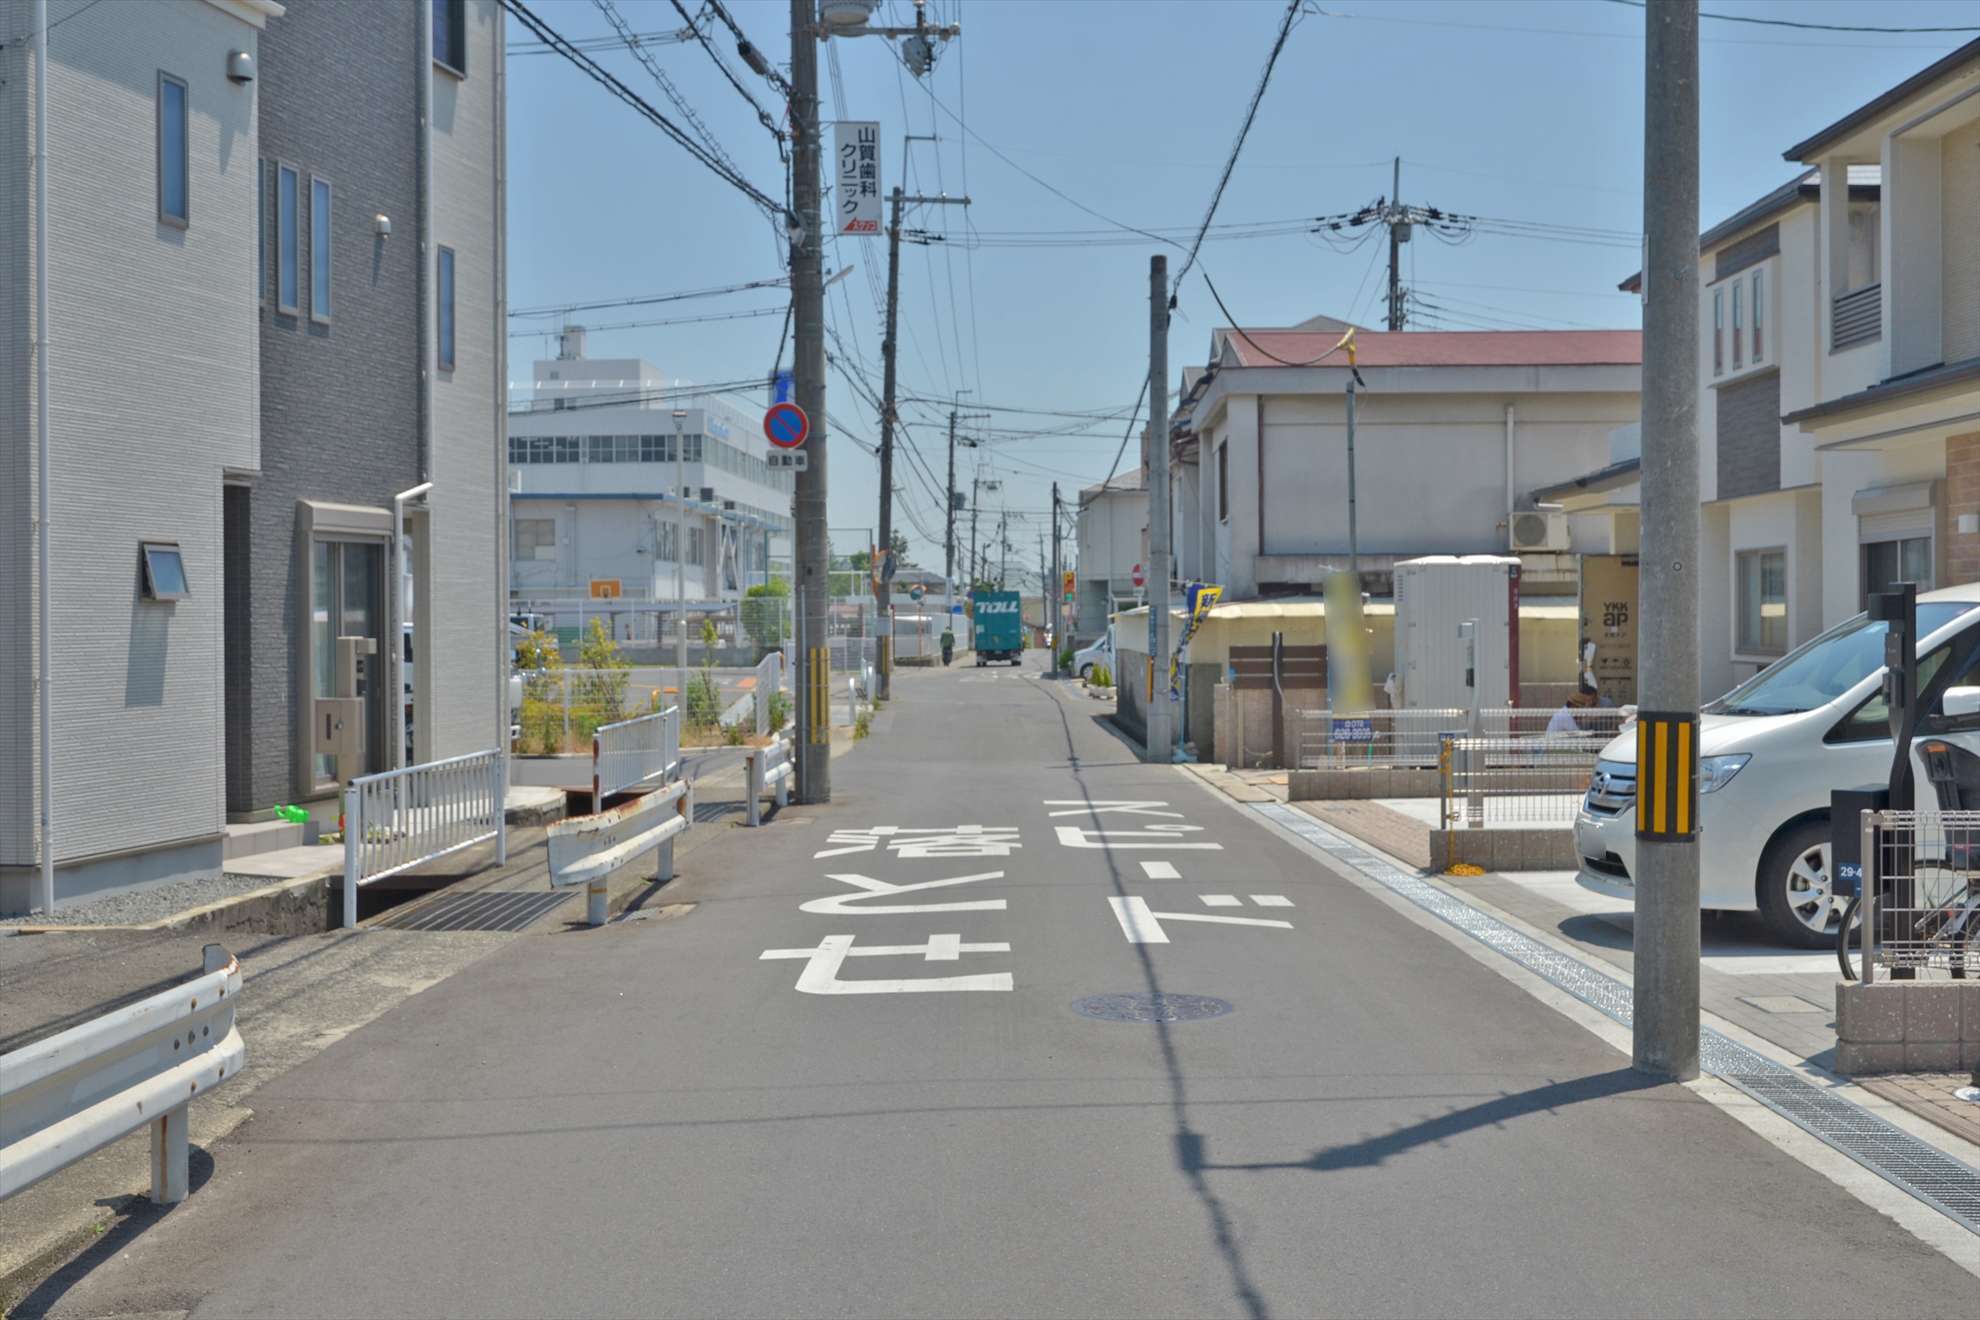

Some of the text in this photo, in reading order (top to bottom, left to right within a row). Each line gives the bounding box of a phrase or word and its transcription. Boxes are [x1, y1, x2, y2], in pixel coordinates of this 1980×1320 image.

[841, 144, 859, 214] クリニック
[769, 455, 805, 466] 自動車
[975, 600, 1019, 614] TOLL
[1603, 601, 1629, 612] YKK
[1603, 612, 1629, 627] ap
[1042, 799, 1296, 944] スピード
